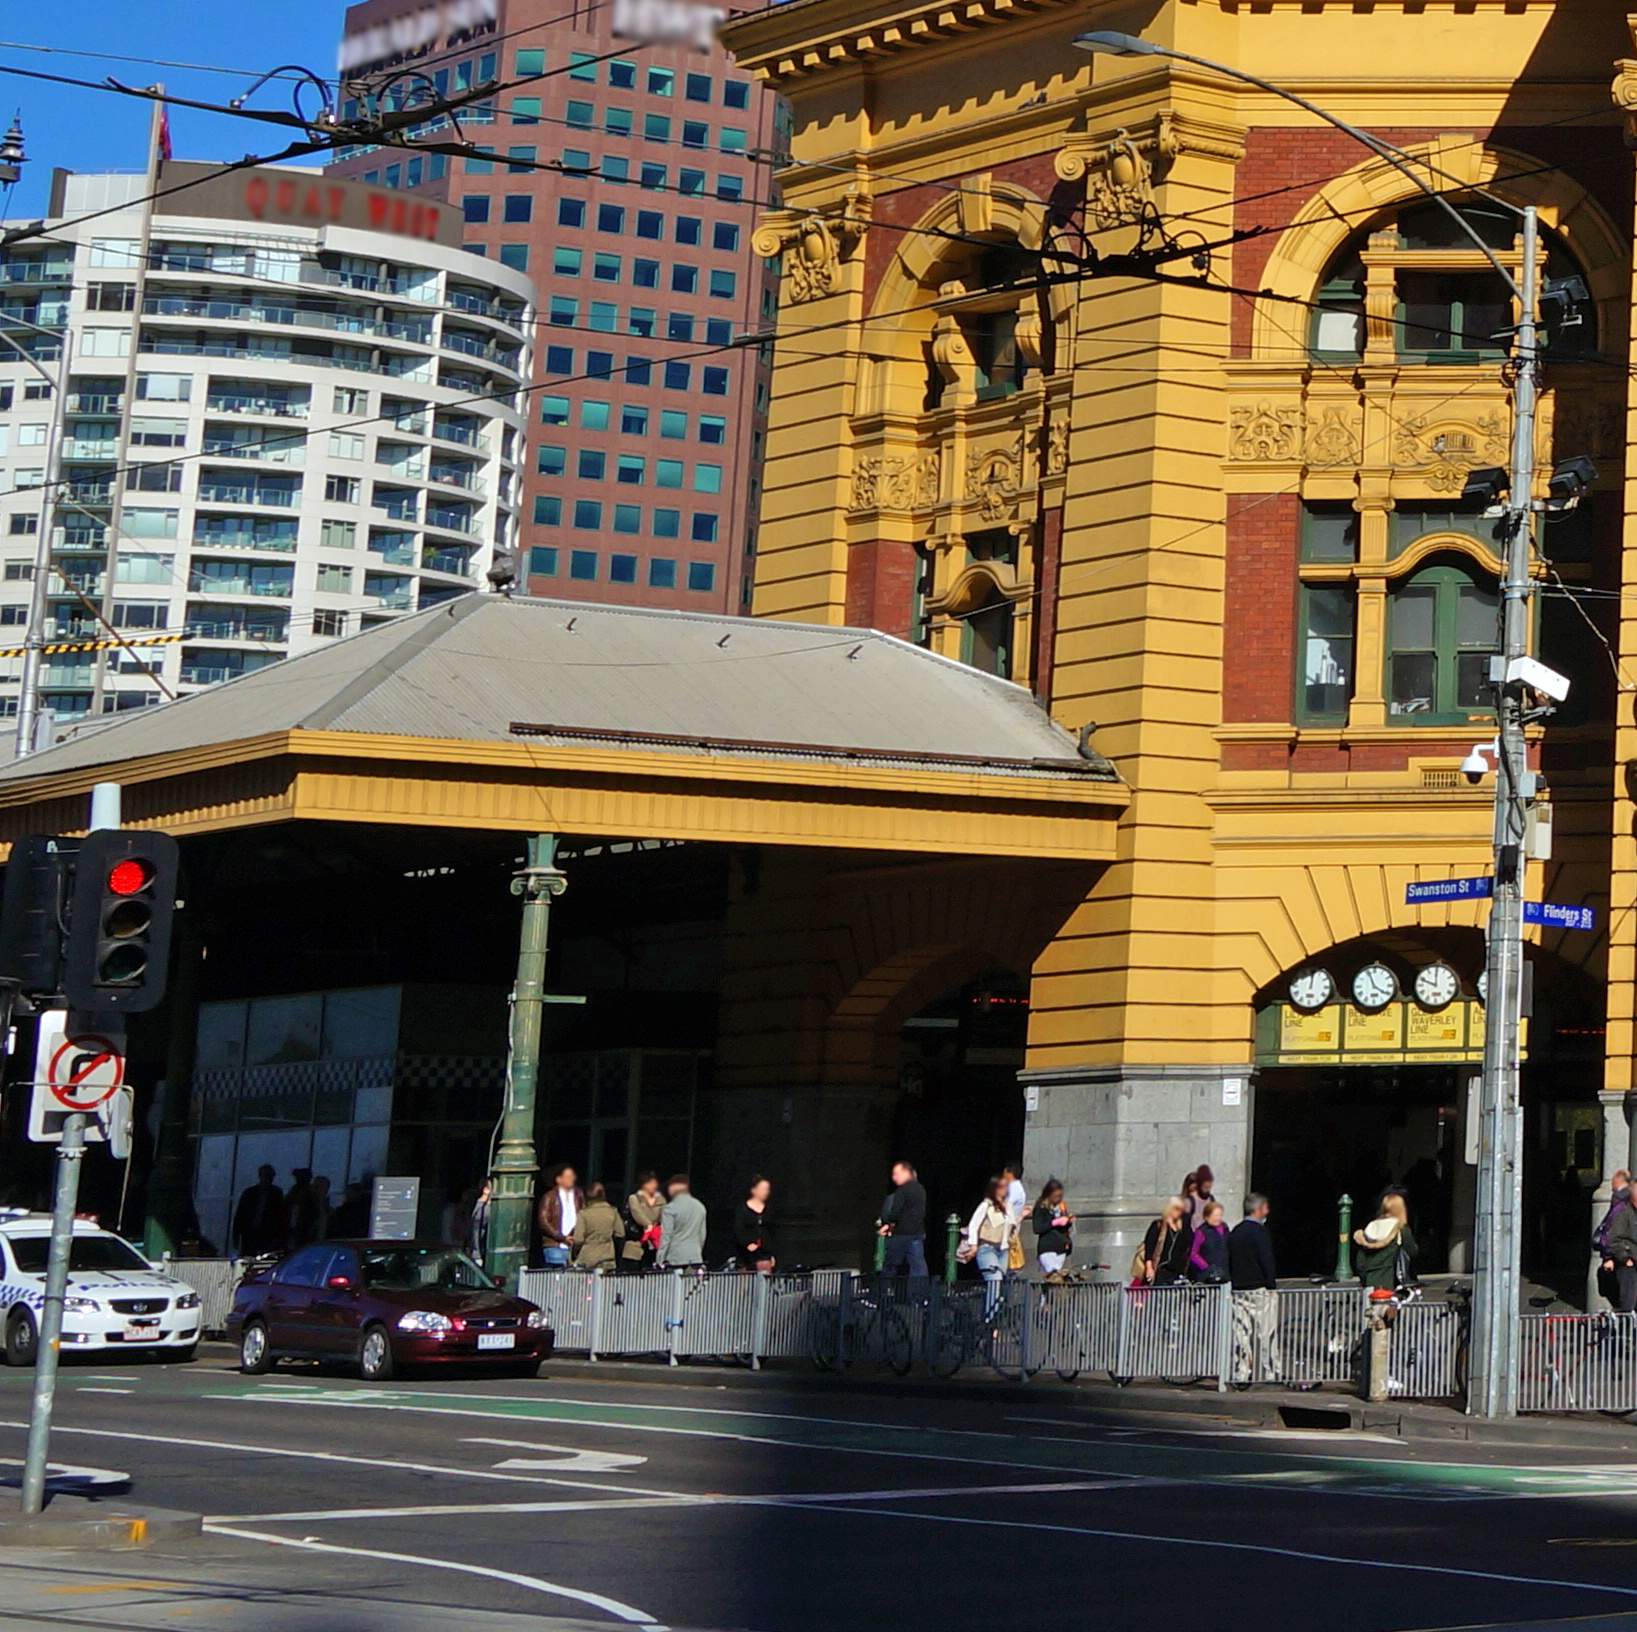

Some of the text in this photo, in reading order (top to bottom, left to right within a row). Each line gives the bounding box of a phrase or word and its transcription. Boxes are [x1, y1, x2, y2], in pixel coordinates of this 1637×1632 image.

[1408, 879, 1470, 898] Swanston St
[1544, 903, 1593, 921] Flinders St
[1284, 1019, 1303, 1028] LINE
[1348, 1018, 1367, 1027] LINE
[1411, 1016, 1457, 1025] WAVERLEY
[1410, 1025, 1430, 1034] LINE
